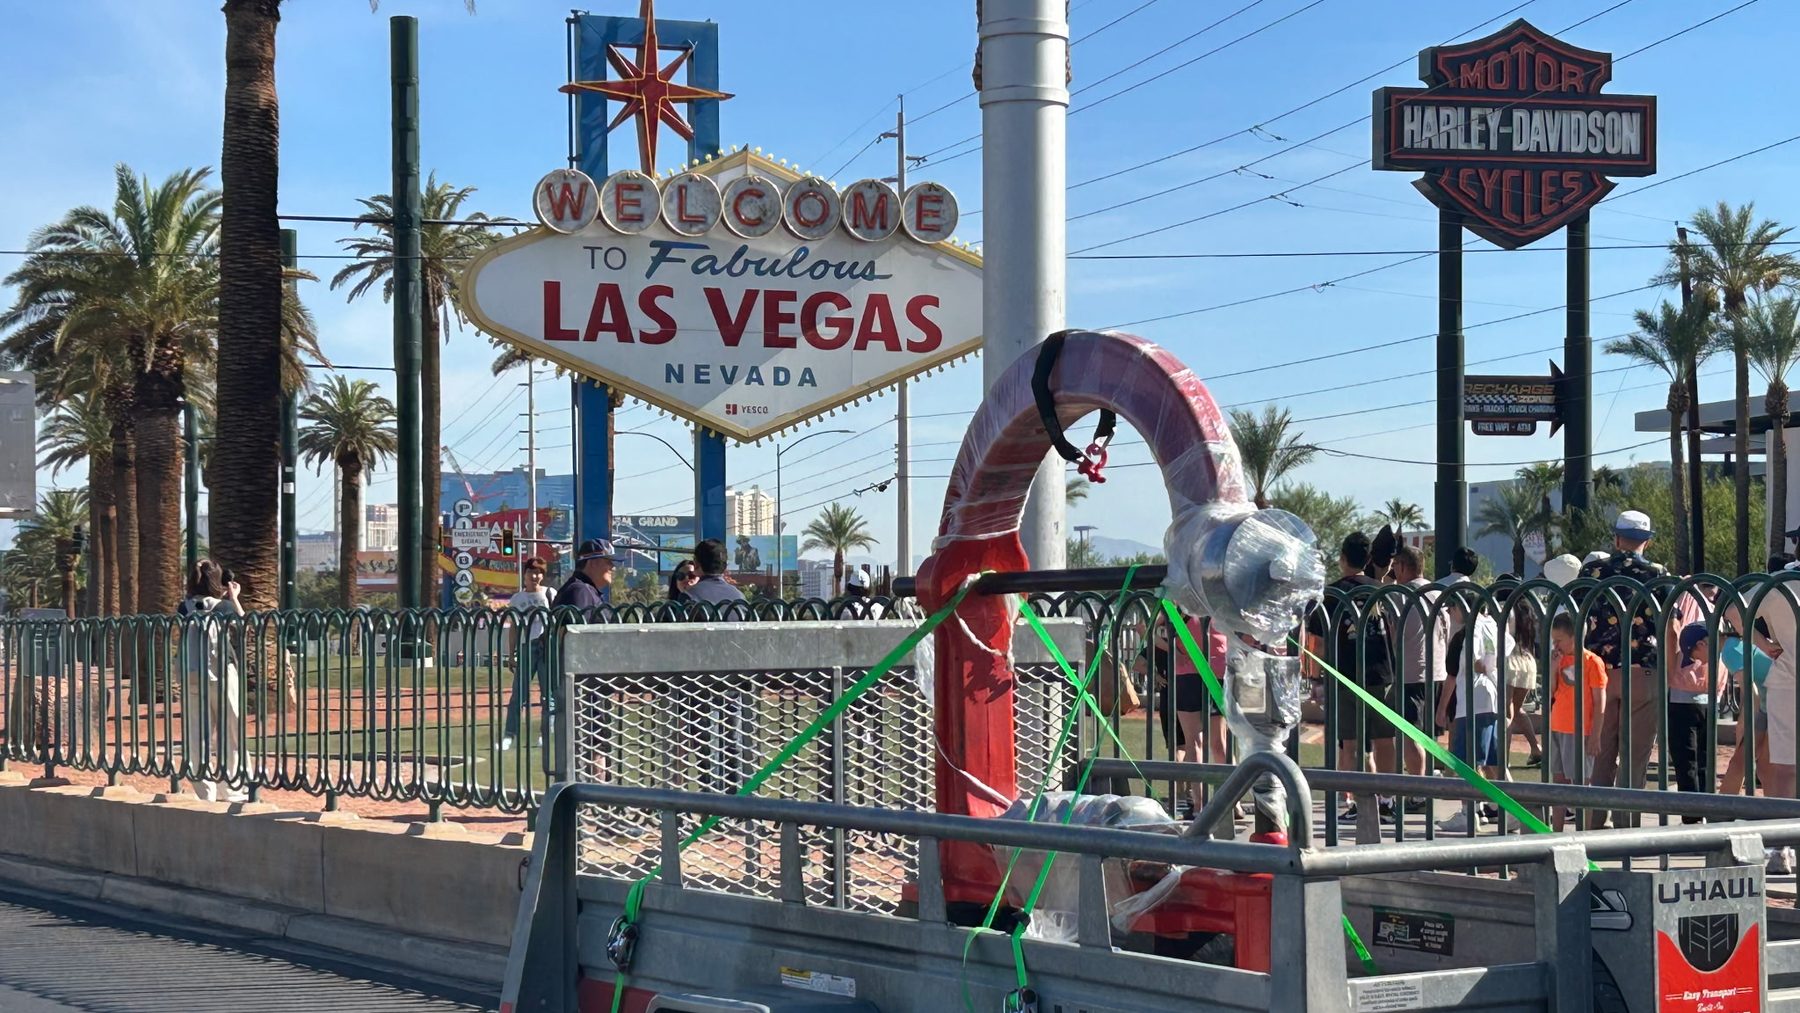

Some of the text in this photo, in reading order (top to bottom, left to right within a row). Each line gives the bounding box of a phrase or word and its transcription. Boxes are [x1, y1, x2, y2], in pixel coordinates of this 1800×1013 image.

[1460, 42, 1584, 93] MOTOR
[1403, 105, 1640, 155] HARLEY-DAVIDSON
[546, 181, 944, 232] WELCOME
[1459, 168, 1583, 222] CYCLES
[583, 240, 893, 281] TO Fabulous
[543, 280, 943, 353] LAS VEGAS
[664, 362, 818, 388] NEVADA
[741, 405, 769, 414] YESCO
[638, 516, 679, 527] GRAND
[1658, 877, 1761, 904] U-HAUL
[1683, 987, 1737, 1001] Easy Transport
